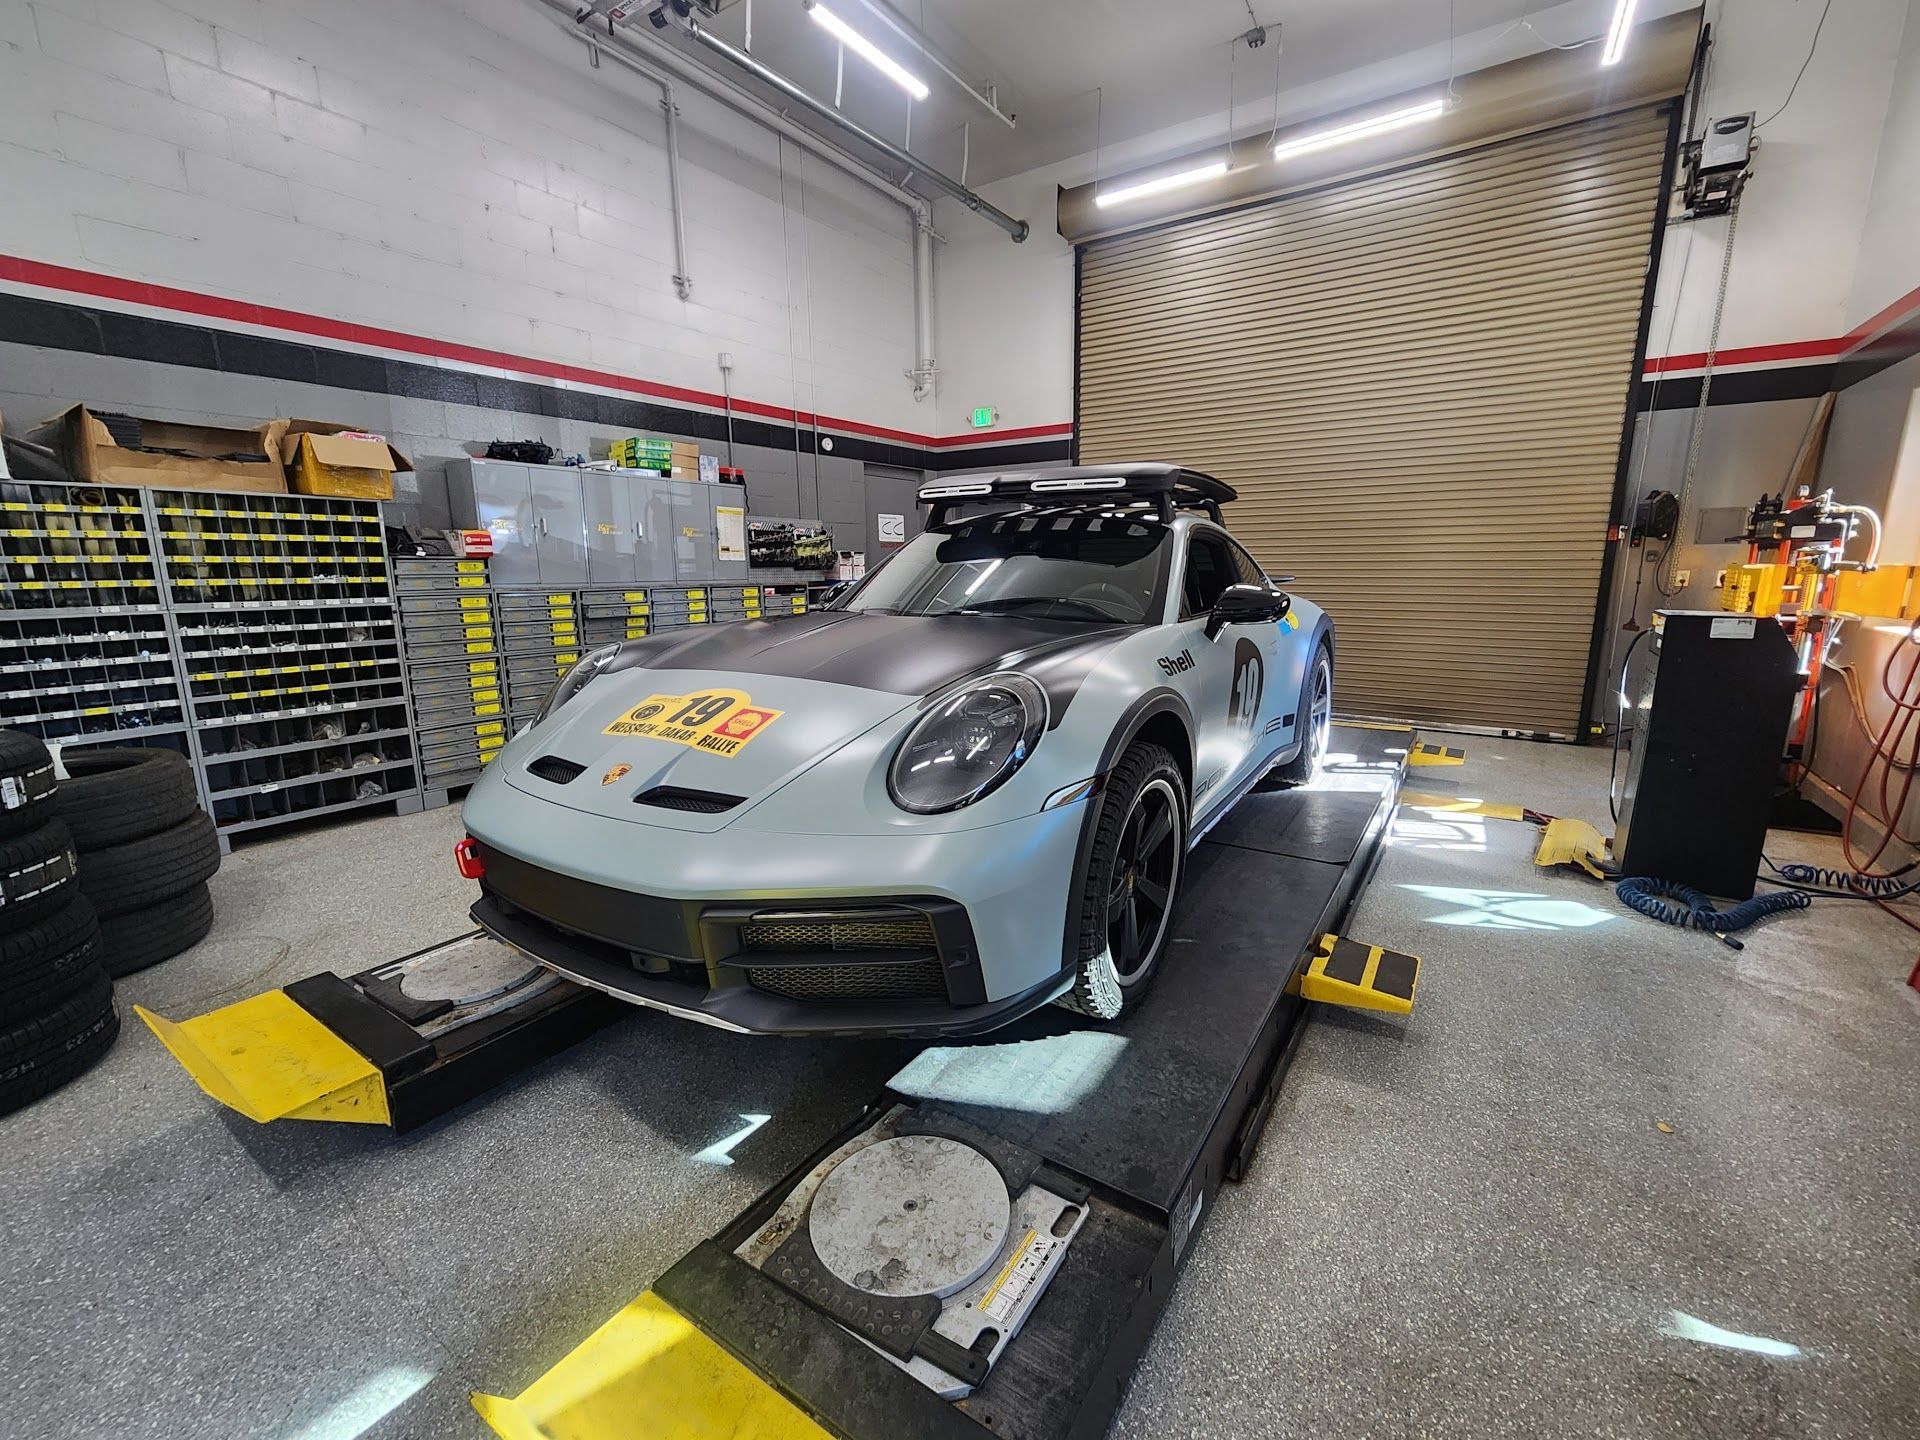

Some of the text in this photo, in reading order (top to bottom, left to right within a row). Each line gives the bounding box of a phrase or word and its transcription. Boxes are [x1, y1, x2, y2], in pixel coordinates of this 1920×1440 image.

[1157, 649, 1196, 677] Shell
[1233, 657, 1260, 729] 19
[665, 695, 735, 727] 19
[608, 722, 741, 754] WEISSACH DAKAR RALLYE
